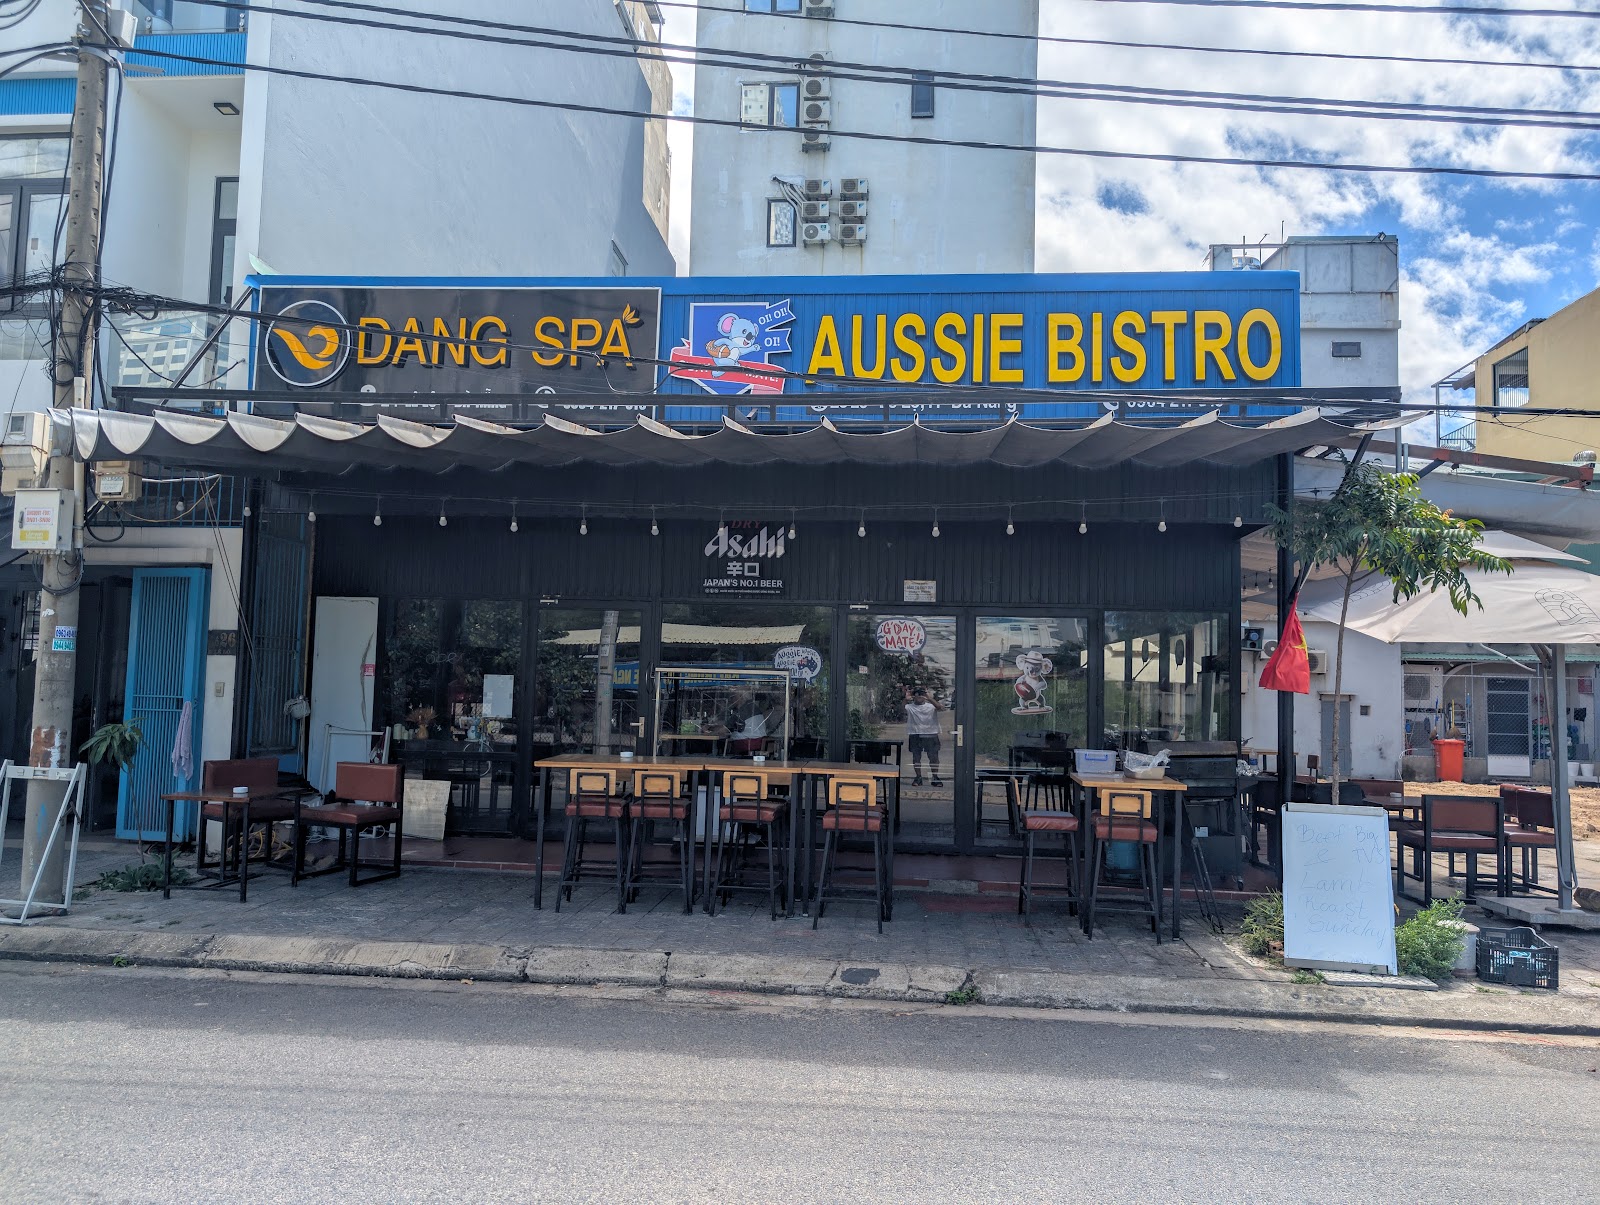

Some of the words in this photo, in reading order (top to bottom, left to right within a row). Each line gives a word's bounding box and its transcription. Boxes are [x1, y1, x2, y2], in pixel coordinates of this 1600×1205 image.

[758, 312, 773, 326] OI!
[773, 306, 788, 319] OI!
[357, 315, 508, 366] DANG
[532, 315, 634, 367] SPA
[764, 337, 781, 347] OI!
[805, 311, 1024, 385] AUSSIE
[1047, 308, 1282, 383] BISTRO
[704, 525, 786, 559] Asahi
[726, 561, 760, 577] 辛口
[703, 578, 738, 587] JAPAN'S
[740, 579, 758, 588] NO.1
[760, 579, 784, 588] BEER
[883, 621, 916, 636] G'DAY
[885, 632, 921, 649] MATE!
[1296, 823, 1345, 844] Beef
[1355, 825, 1379, 848] Big
[1299, 893, 1370, 919] Roast
[1305, 913, 1387, 949] Sunday
